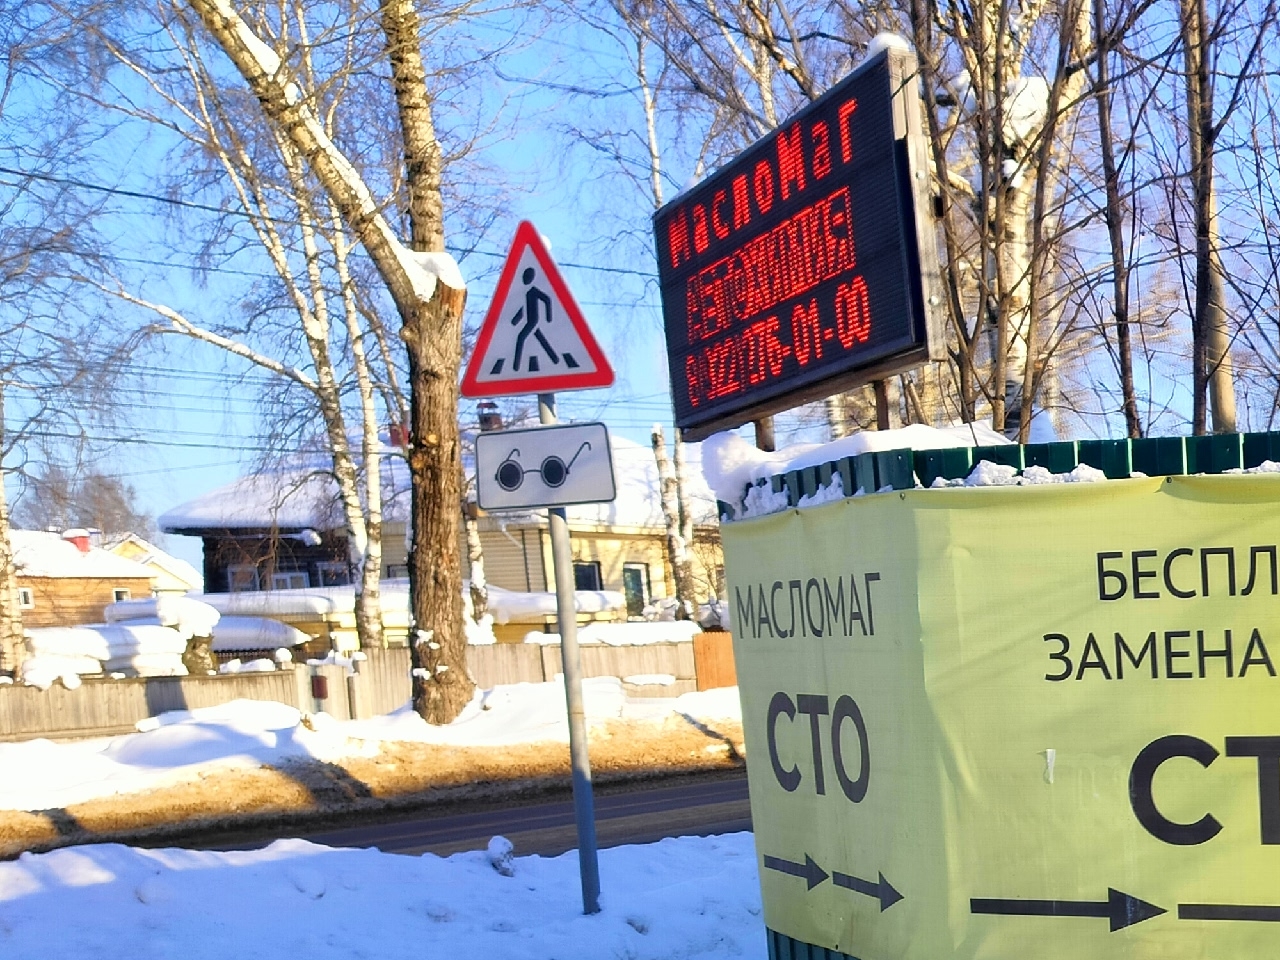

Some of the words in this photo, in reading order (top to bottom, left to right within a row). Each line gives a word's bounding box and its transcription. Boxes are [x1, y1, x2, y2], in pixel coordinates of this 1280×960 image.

[735, 571, 881, 639] МАСЛОМАГ
[1043, 627, 1277, 682] ЗАМЕНА
[766, 691, 871, 804] СТО
